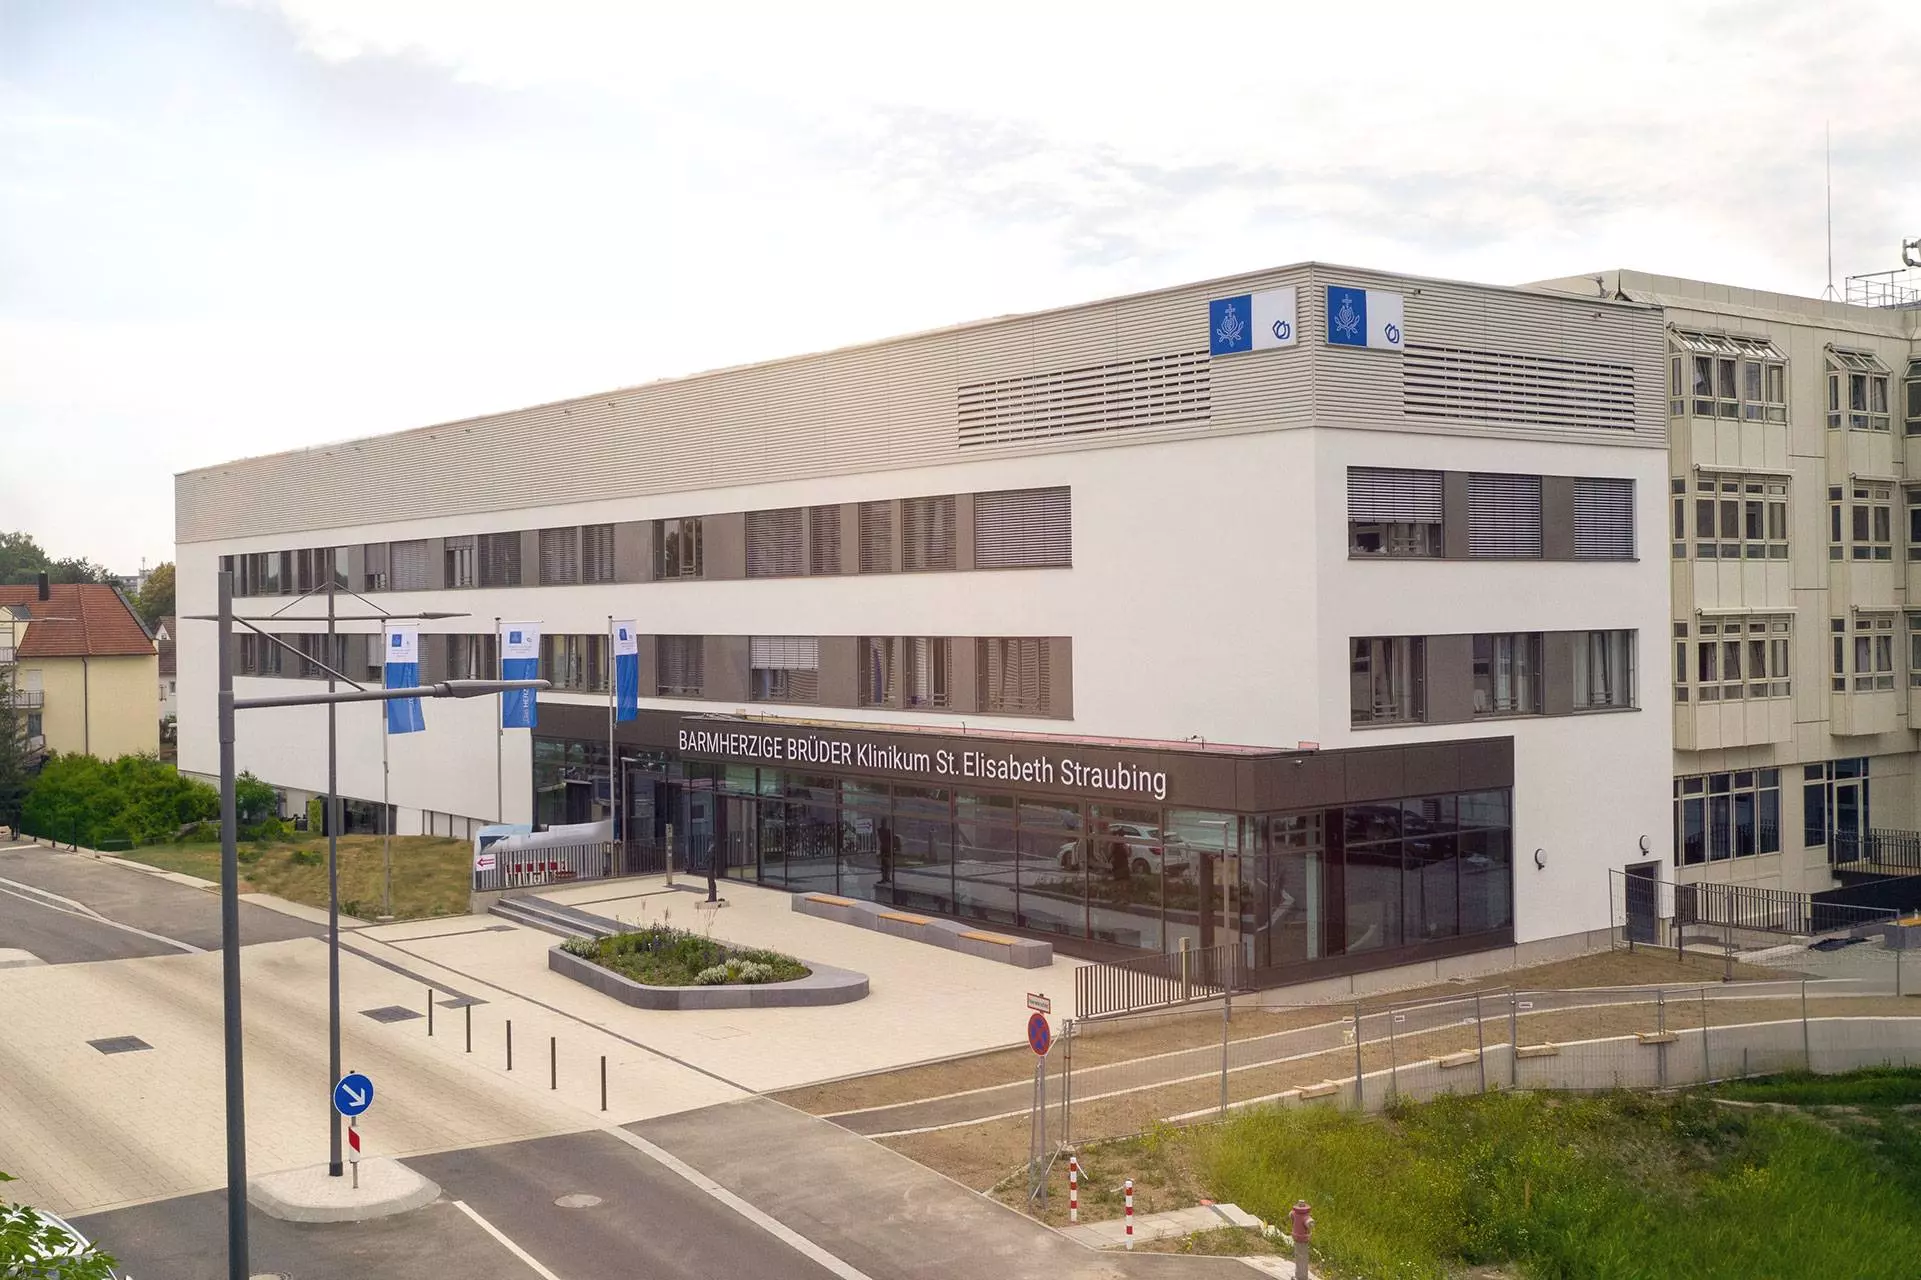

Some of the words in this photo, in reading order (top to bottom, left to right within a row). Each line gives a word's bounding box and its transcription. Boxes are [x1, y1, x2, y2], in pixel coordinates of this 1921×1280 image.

[679, 730, 783, 759] BARMHERZIGE
[787, 735, 852, 765] BRÜDER
[856, 743, 930, 773] Klinikum
[936, 750, 960, 776] St.
[963, 751, 1054, 784] Elisabeth
[1060, 759, 1168, 801] Straubing
